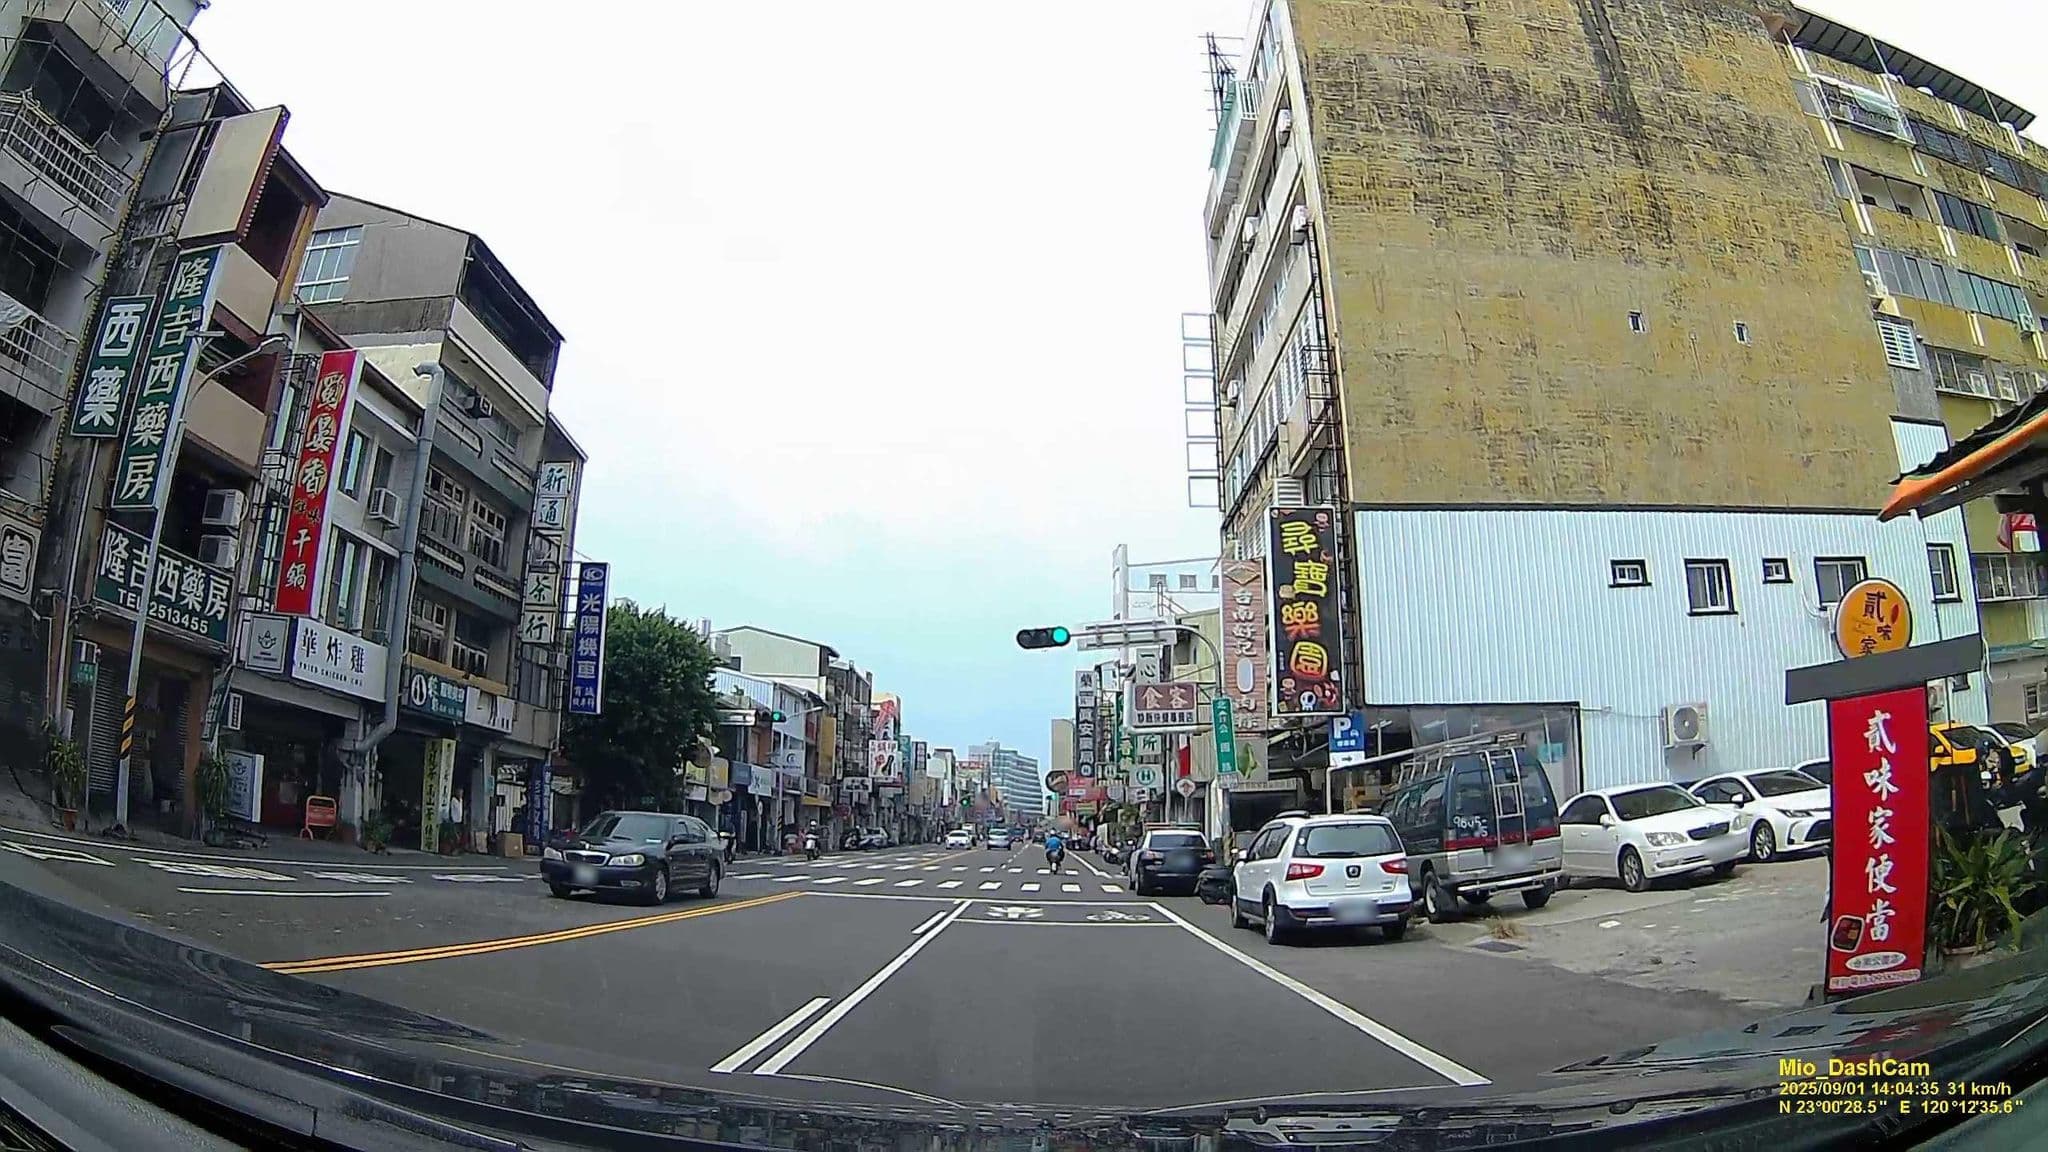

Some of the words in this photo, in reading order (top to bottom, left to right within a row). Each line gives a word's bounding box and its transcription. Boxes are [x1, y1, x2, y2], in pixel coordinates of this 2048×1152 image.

[80, 302, 147, 427] 西藥
[120, 256, 210, 501] 隆吉西藥房
[100, 527, 231, 621] 隆吉西藥房
[148, 601, 209, 634] 2513455
[1281, 521, 1329, 678] 尋寶樂園
[576, 592, 602, 679] 光陽機車
[1142, 685, 1189, 709] 食客
[1333, 717, 1352, 739] P
[1863, 709, 1900, 942] 貳味家便當
